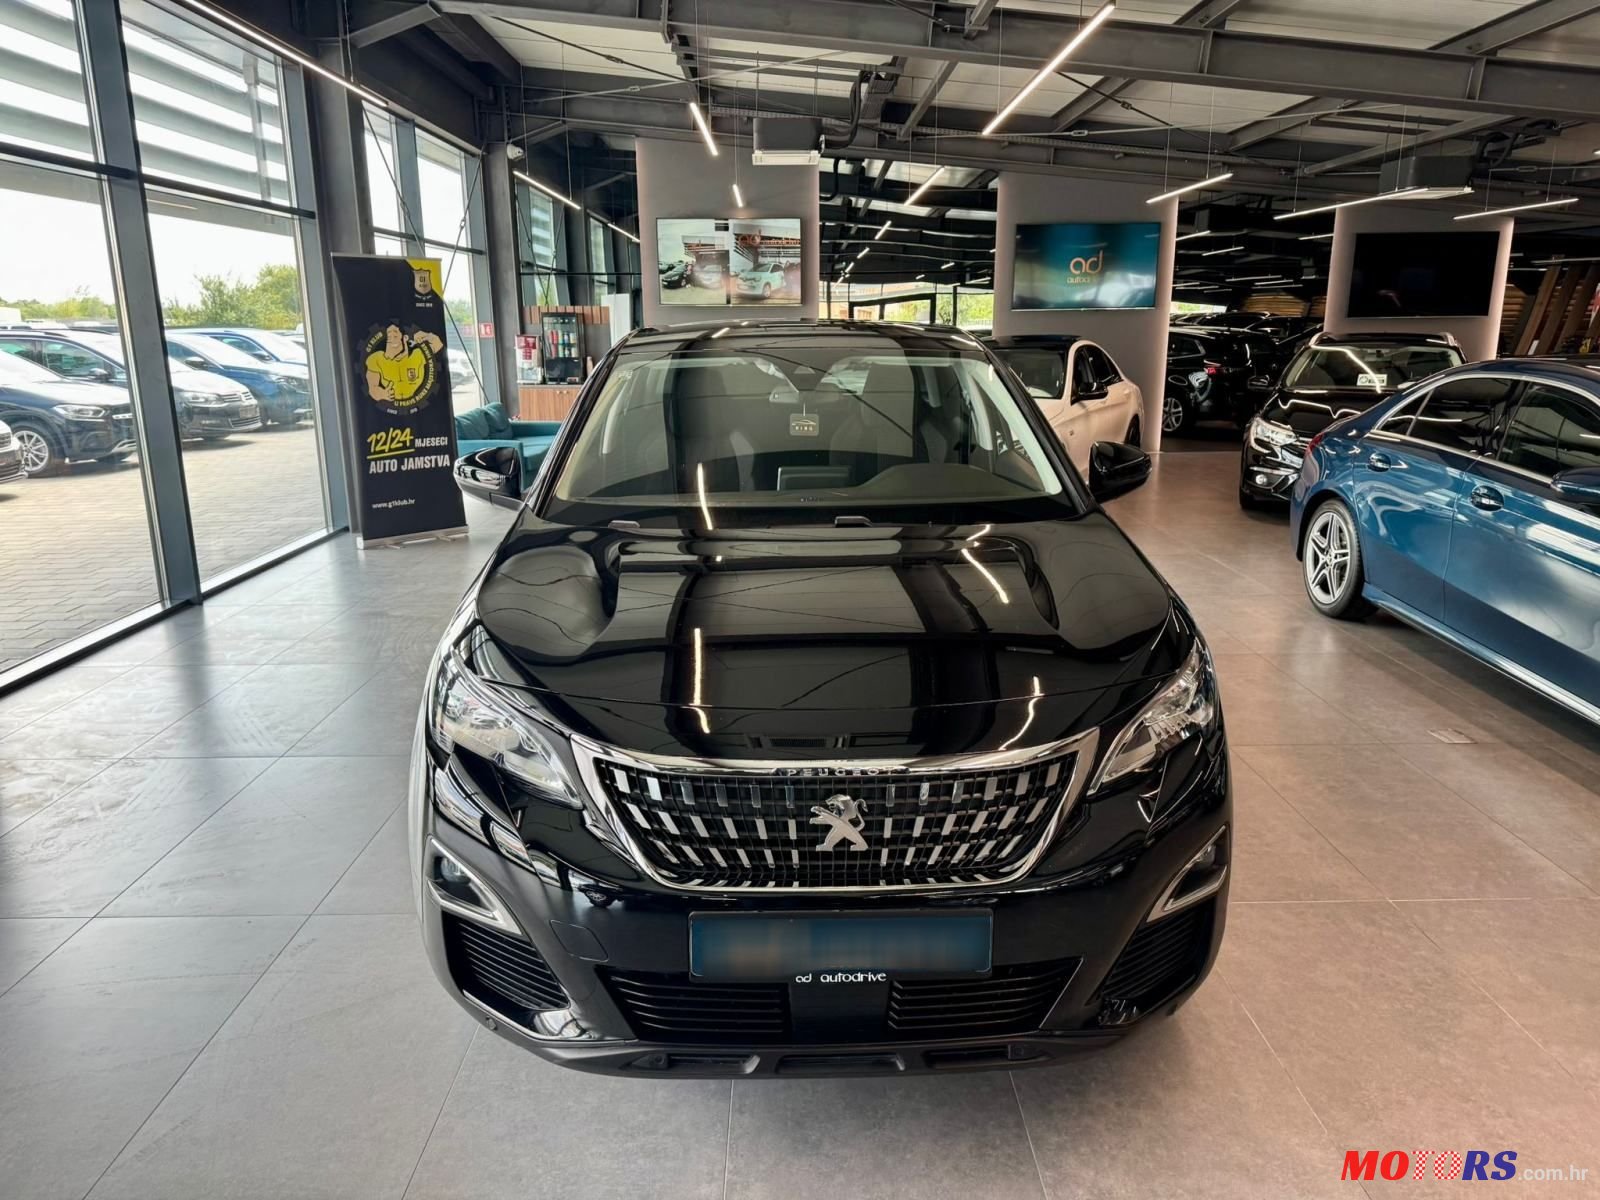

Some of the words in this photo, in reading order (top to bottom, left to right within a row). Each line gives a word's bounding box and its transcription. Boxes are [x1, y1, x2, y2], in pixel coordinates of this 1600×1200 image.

[1070, 249, 1104, 274] ad
[367, 427, 414, 453] 12/24
[414, 436, 448, 448] MJESECI
[369, 459, 398, 474] AUTO
[401, 454, 451, 471] JAMSTVA
[787, 767, 896, 776] PEUGEOT
[795, 973, 812, 983] ad
[820, 972, 887, 983] autodrive
